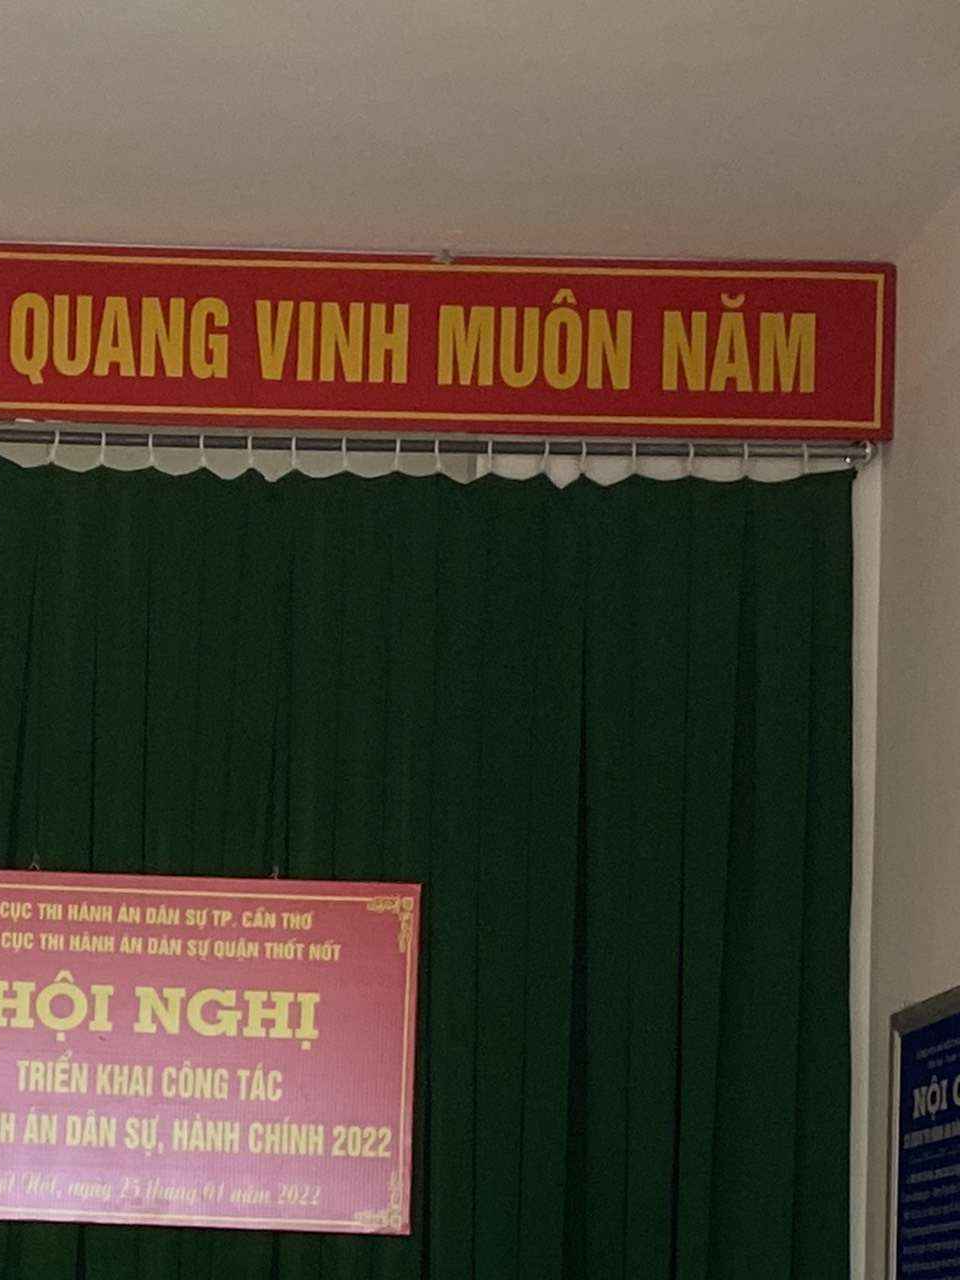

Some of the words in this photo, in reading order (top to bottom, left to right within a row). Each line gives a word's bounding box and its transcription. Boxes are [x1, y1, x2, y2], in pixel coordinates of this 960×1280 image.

[9, 291, 230, 384] QUANG
[255, 299, 411, 384] VINH
[437, 288, 633, 391] MUÔN
[661, 291, 818, 394] NĂM
[0, 901, 33, 922] CỤC
[37, 903, 63, 920] THI
[67, 901, 113, 923] HÀNH
[145, 904, 181, 925] DÂN
[185, 907, 208, 930] SỰ
[212, 909, 237, 927] TP.
[280, 910, 315, 930] THƠ
[1, 931, 35, 953] CỤC
[39, 933, 65, 951] THI
[69, 931, 115, 954] HÀNH
[147, 934, 182, 956] DÂN
[187, 937, 211, 960] SỰ
[214, 937, 259, 961] QUẬN
[264, 937, 305, 960] THỐT
[309, 939, 341, 961] NỐT
[133, 985, 321, 1050] NGHỊ
[16, 1050, 89, 1094] TRIỂN
[95, 1063, 154, 1097] KHAI
[161, 1060, 230, 1100] CÔNG
[237, 1063, 283, 1102] TÁC
[912, 1074, 948, 1121] NỘI
[22, 1106, 58, 1146] ÁN
[65, 1109, 117, 1147] DÂN
[124, 1114, 165, 1157] SỰ,
[173, 1113, 241, 1152] HÀNH
[248, 1116, 325, 1157] CHÍNH
[331, 1125, 393, 1158] 2022
